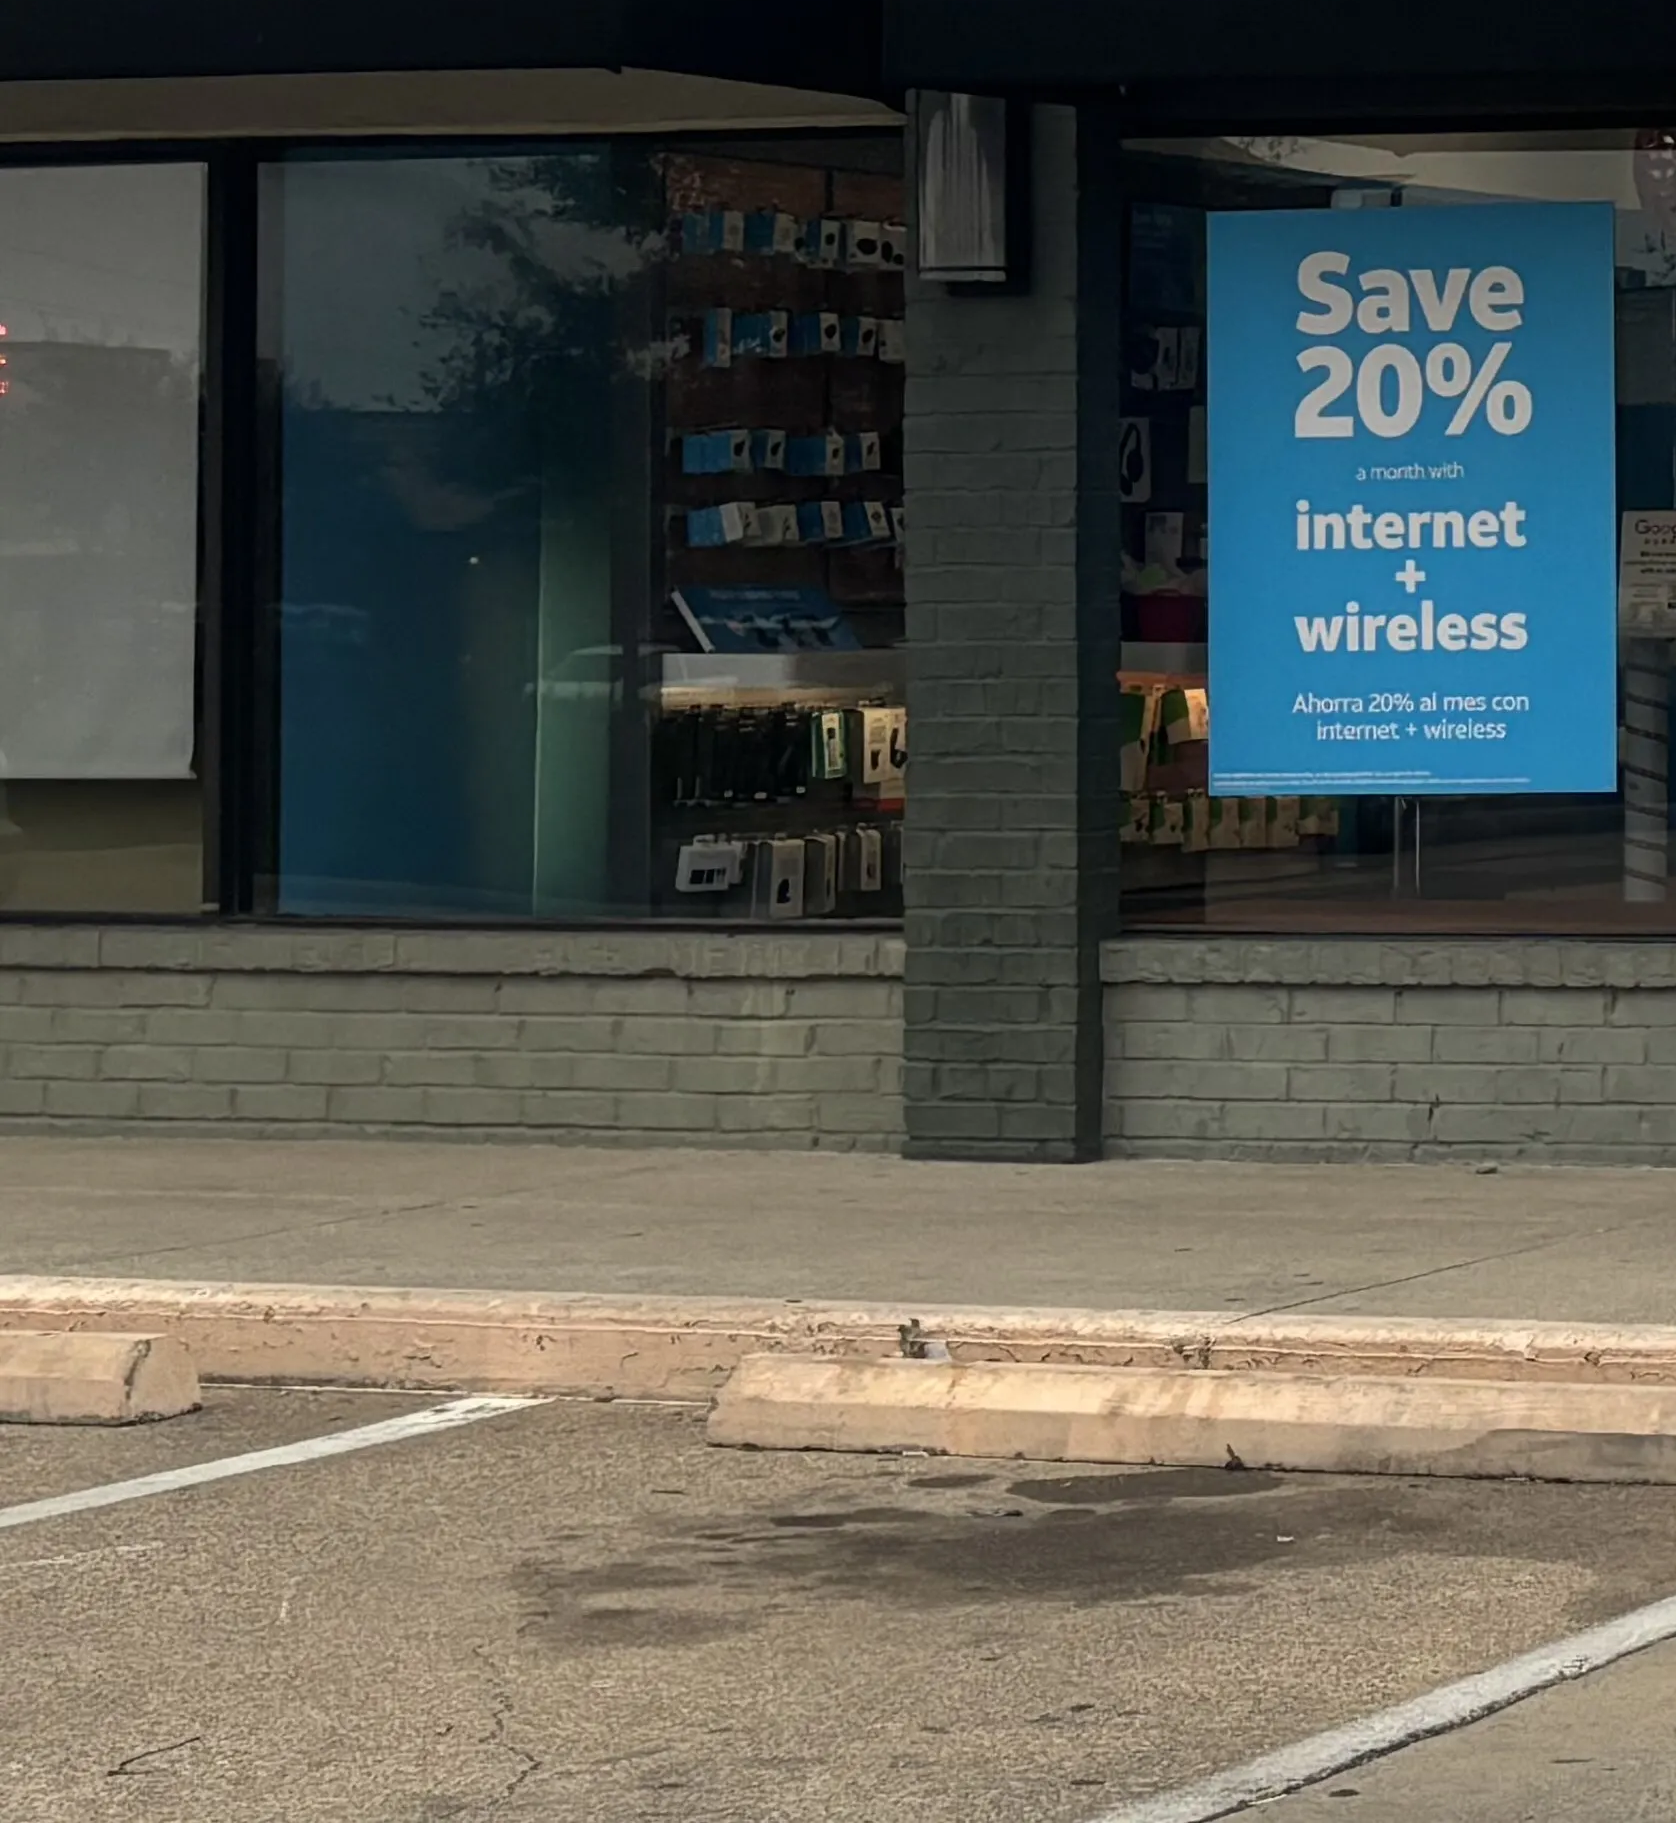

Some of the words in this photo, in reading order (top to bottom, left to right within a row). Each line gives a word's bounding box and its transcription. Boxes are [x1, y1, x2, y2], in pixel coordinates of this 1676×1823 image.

[1296, 251, 1524, 335] Save
[1295, 342, 1532, 438] 20%
[1355, 467, 1367, 481] a
[1370, 463, 1425, 480] month
[1427, 461, 1465, 479] with
[1296, 499, 1528, 550] internet
[1395, 559, 1426, 593] +
[1294, 600, 1528, 652] wireless
[1292, 692, 1363, 713] Ahorra
[1367, 693, 1413, 713] 20%
[1419, 691, 1436, 712] al
[1443, 695, 1486, 712] mes
[1492, 695, 1529, 711] con
[1316, 720, 1399, 740] internet
[1404, 722, 1417, 737] +
[1423, 718, 1507, 739] wireless
